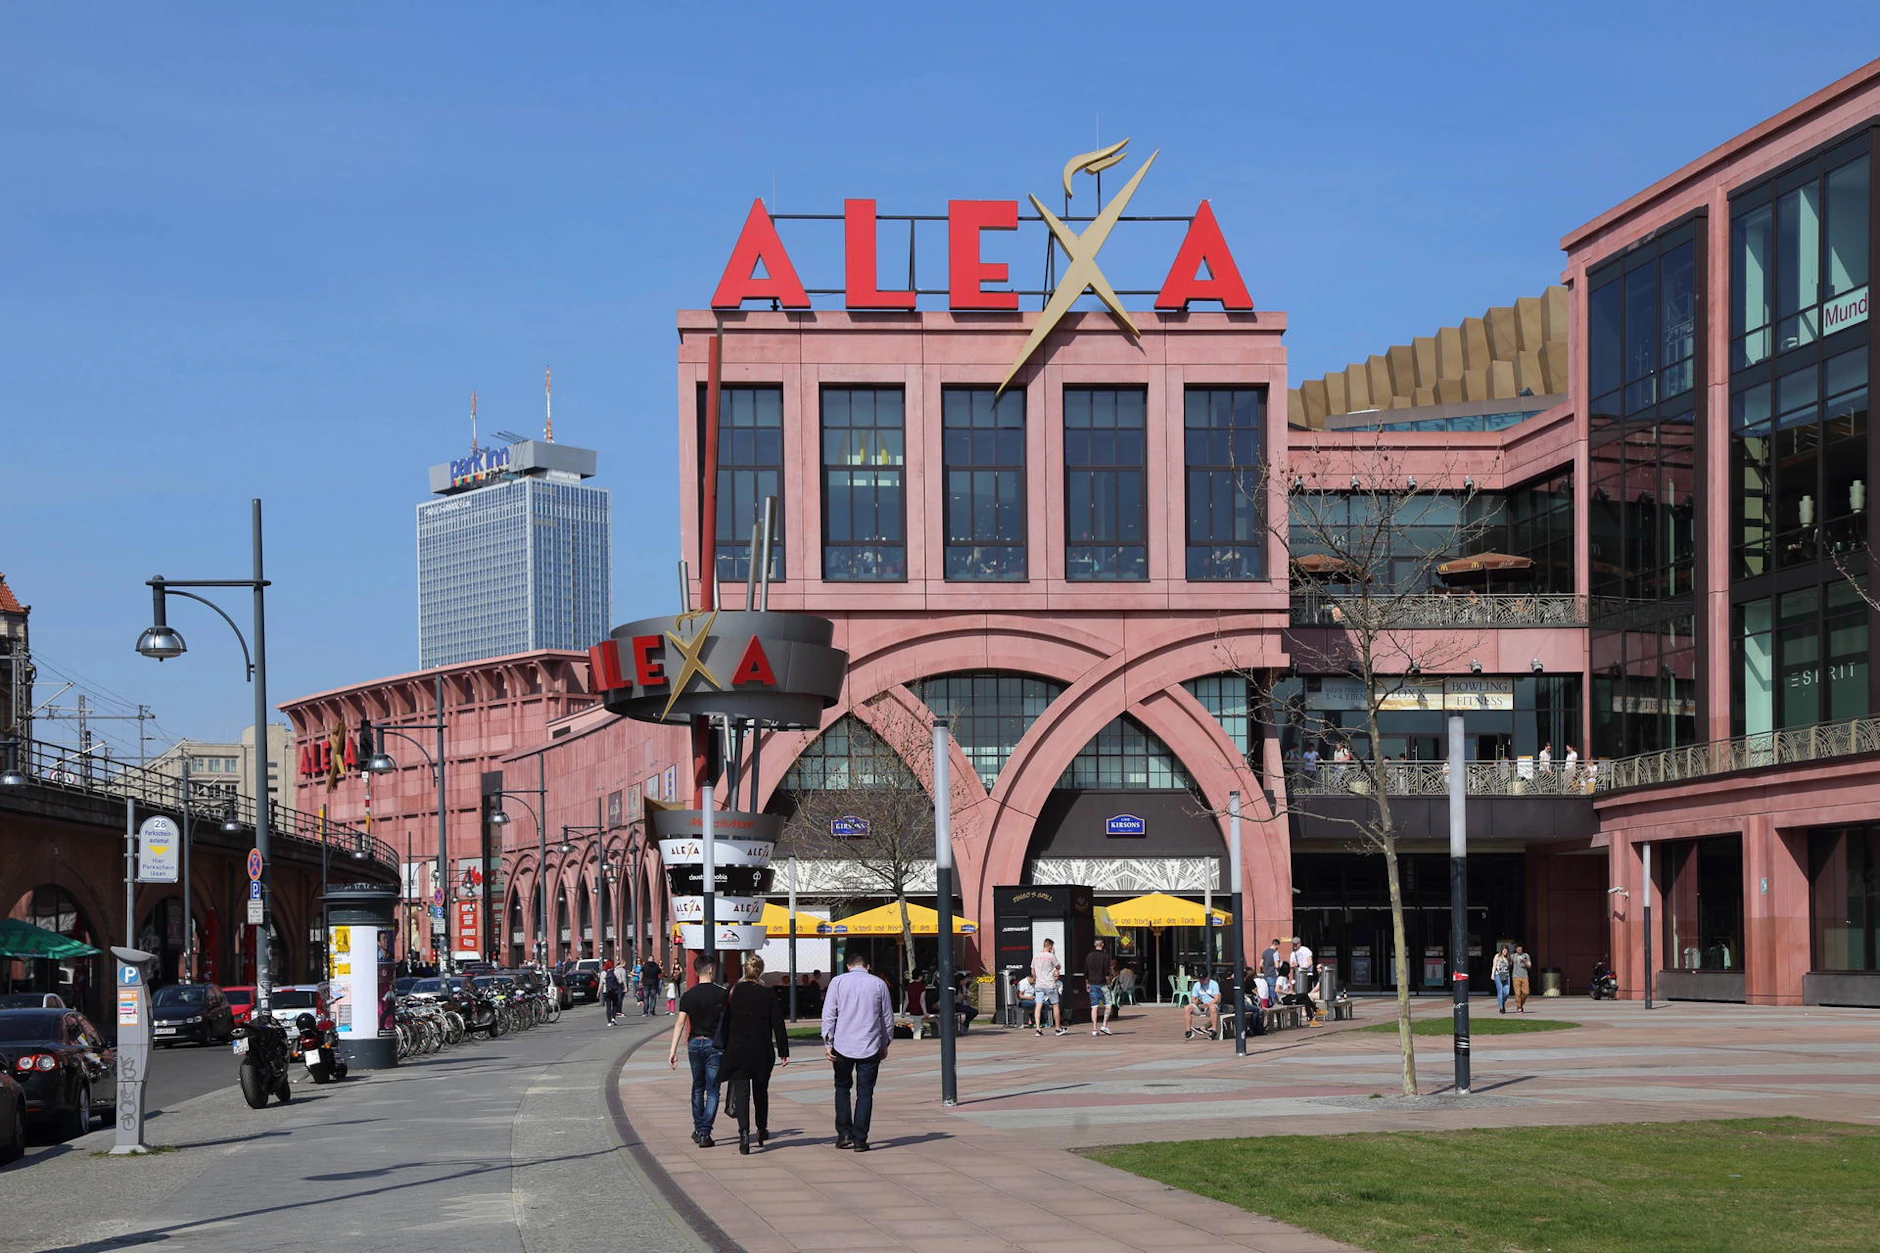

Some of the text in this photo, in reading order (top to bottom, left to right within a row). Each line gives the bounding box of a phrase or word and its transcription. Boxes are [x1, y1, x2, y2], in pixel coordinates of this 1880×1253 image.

[710, 138, 1254, 397] ALEXA
[1452, 681, 1508, 692] BOWLING
[1456, 695, 1503, 706] FITNESS
[155, 820, 167, 828] 28
[1110, 821, 1141, 829] KIRSONS
[671, 842, 700, 861] ALEXA
[676, 899, 701, 918] ALEXA
[124, 966, 137, 984] P
